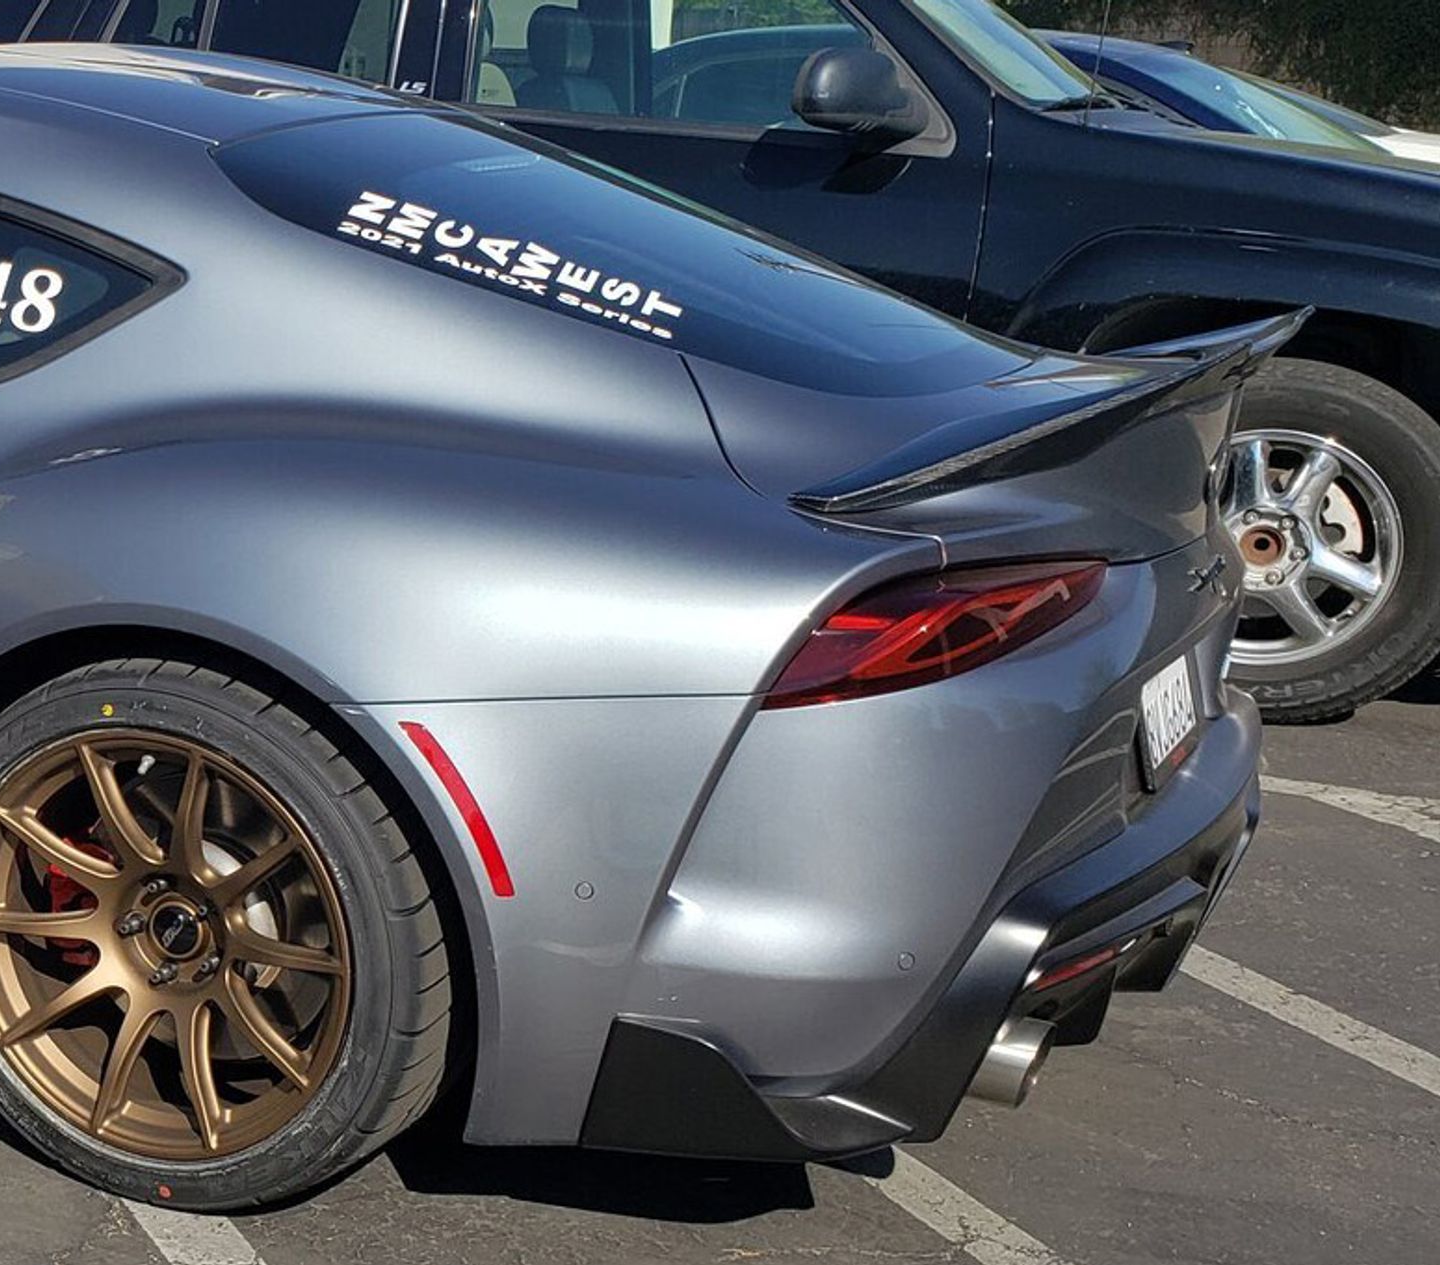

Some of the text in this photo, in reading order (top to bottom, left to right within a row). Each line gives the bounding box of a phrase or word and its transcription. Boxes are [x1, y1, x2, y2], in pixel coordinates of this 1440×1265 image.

[400, 81, 427, 94] LS
[336, 221, 673, 340] 2021 AutoX Series
